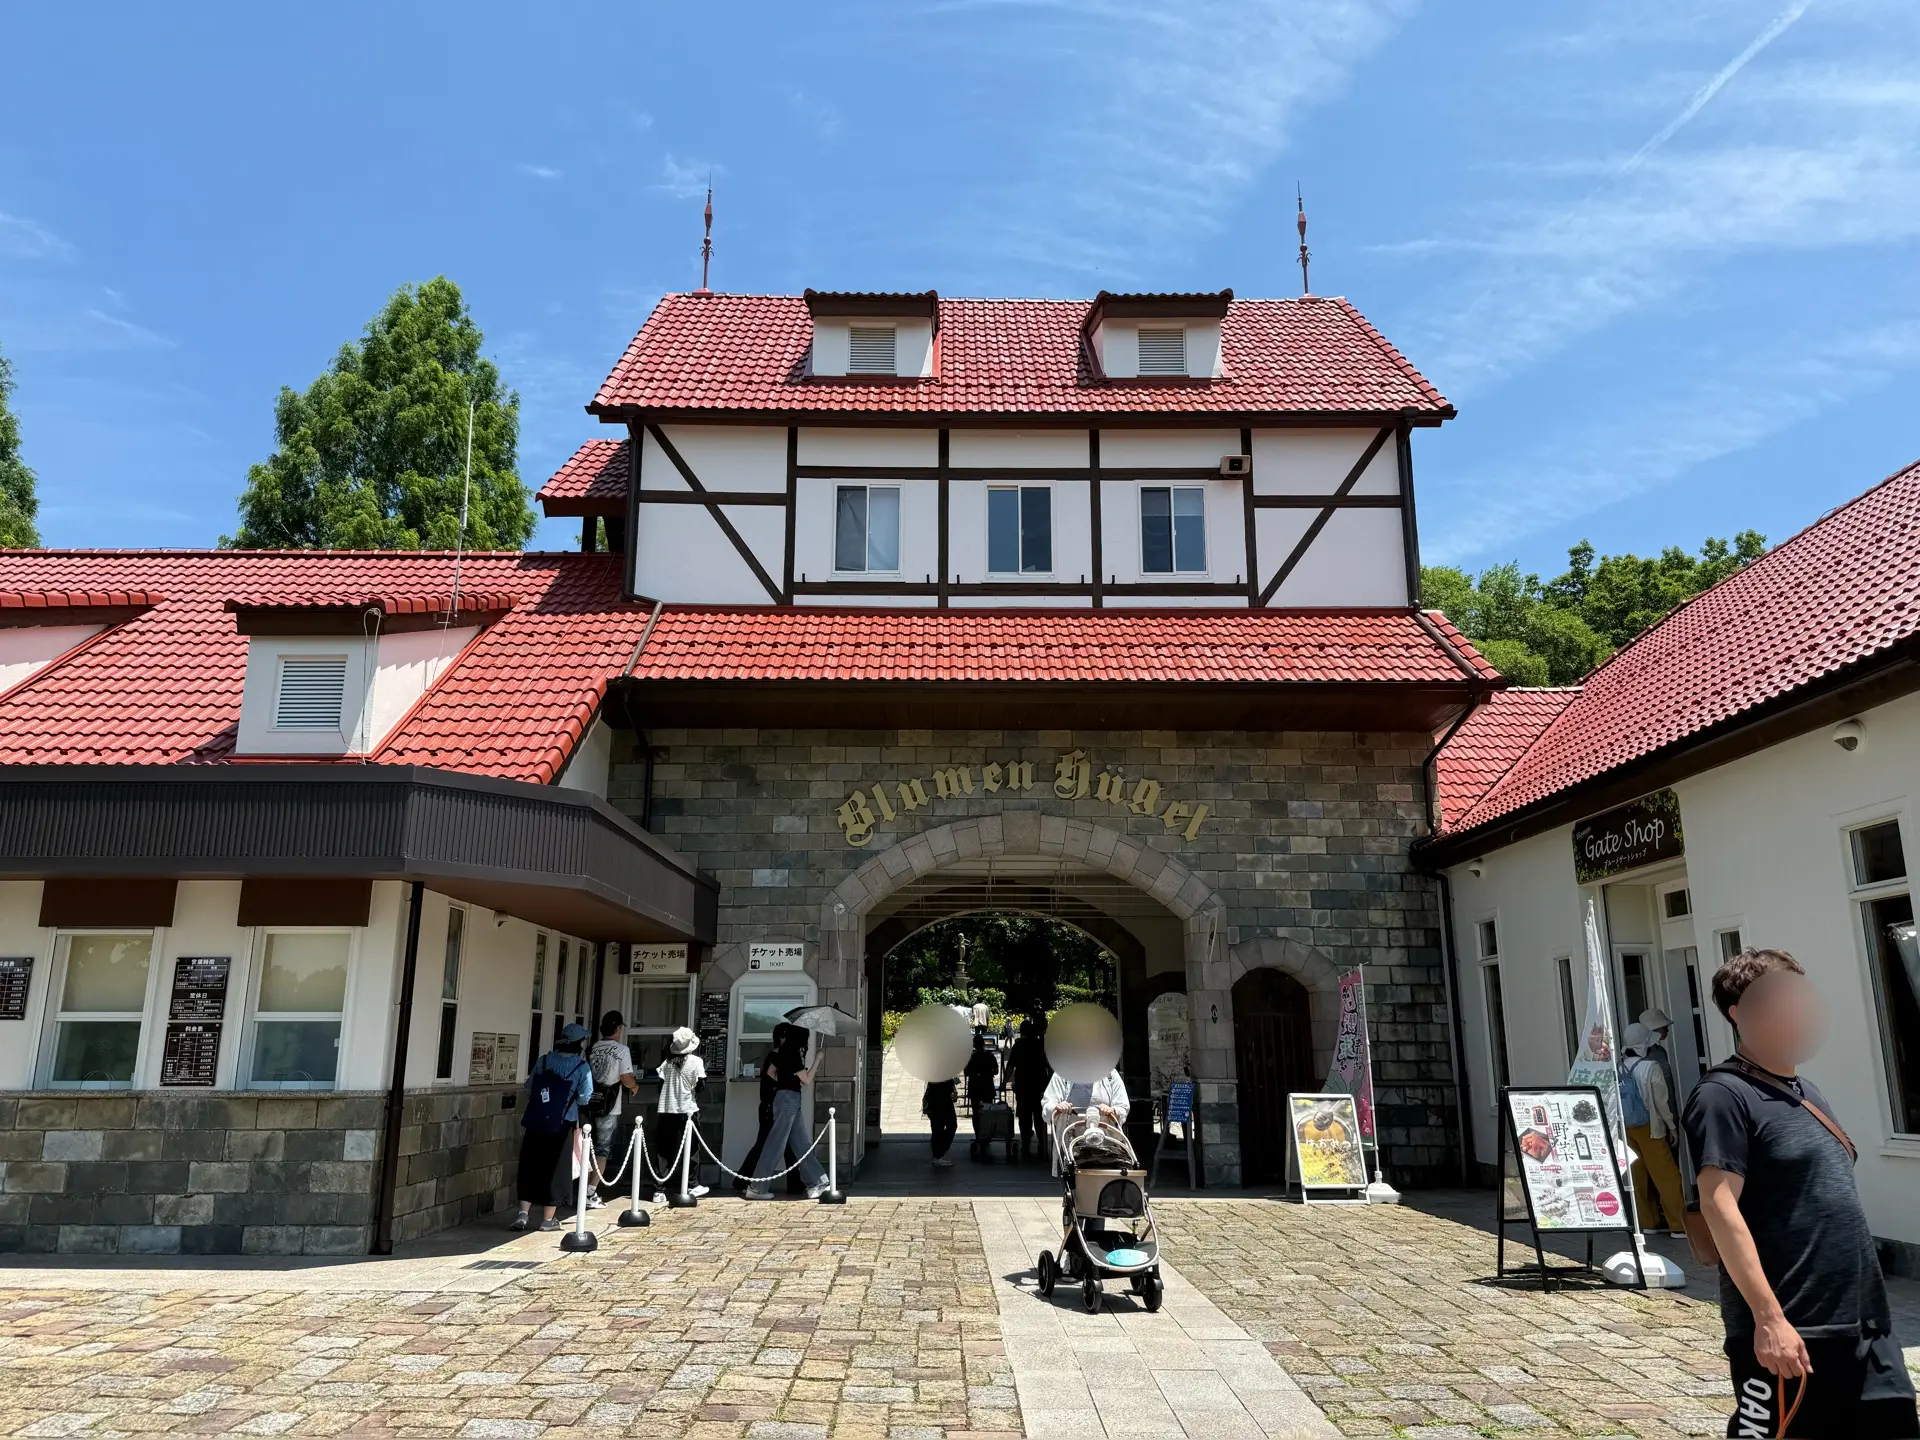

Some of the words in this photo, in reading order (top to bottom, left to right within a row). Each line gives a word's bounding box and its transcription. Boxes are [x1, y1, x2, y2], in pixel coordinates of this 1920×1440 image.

[837, 759, 1035, 847] Blumen
[1054, 749, 1210, 843] Hügel
[1585, 831, 1623, 860] Gate
[1624, 818, 1665, 849] Shop
[632, 949, 685, 960] チケット売場
[751, 947, 803, 958] チケット売場
[1738, 1377, 1773, 1440] OAK
